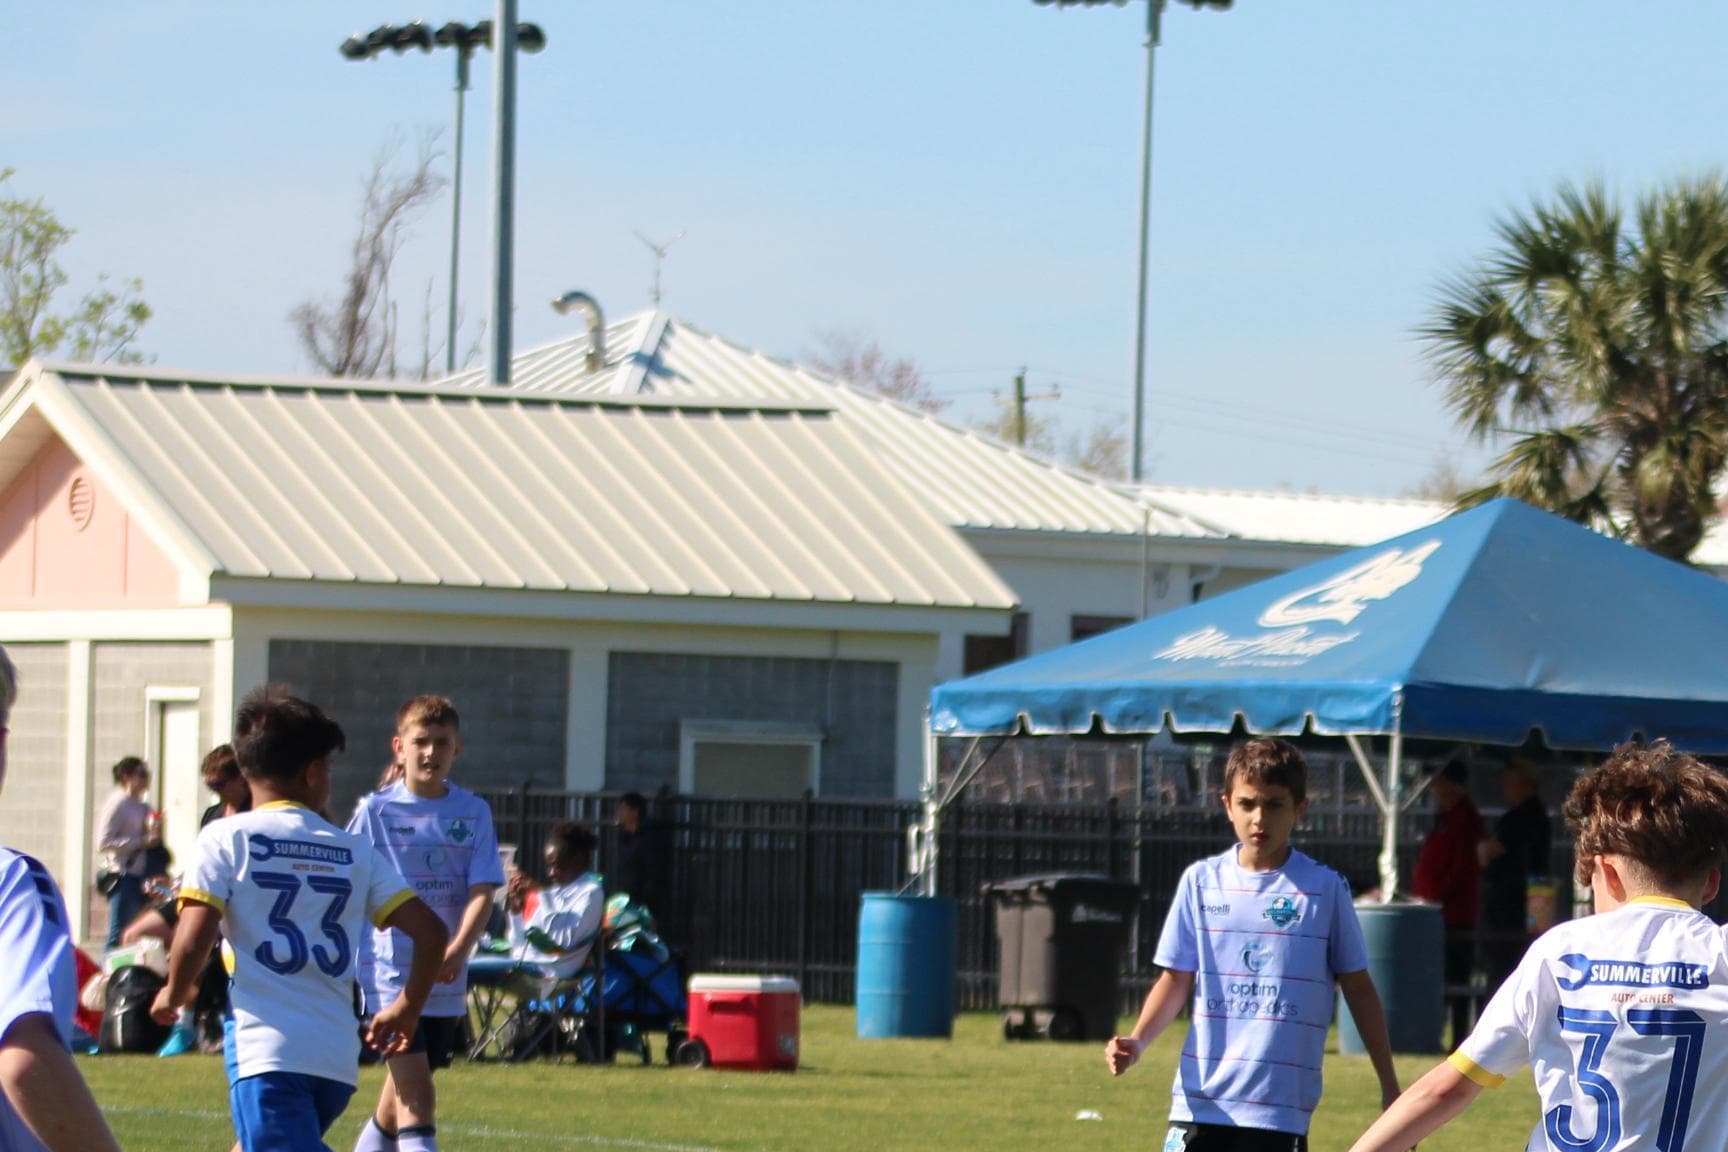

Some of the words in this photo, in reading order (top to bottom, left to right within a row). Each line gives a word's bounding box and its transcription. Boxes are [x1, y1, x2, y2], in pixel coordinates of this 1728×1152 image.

[273, 842, 349, 863] SUMMERVILLE
[1200, 903, 1230, 914] capelli
[251, 871, 353, 978] 33
[1590, 964, 1703, 985] SUMMERVILLE
[1230, 982, 1278, 998] optim
[1639, 993, 1675, 1004] CENTER
[1207, 997, 1299, 1017] ortopdcs
